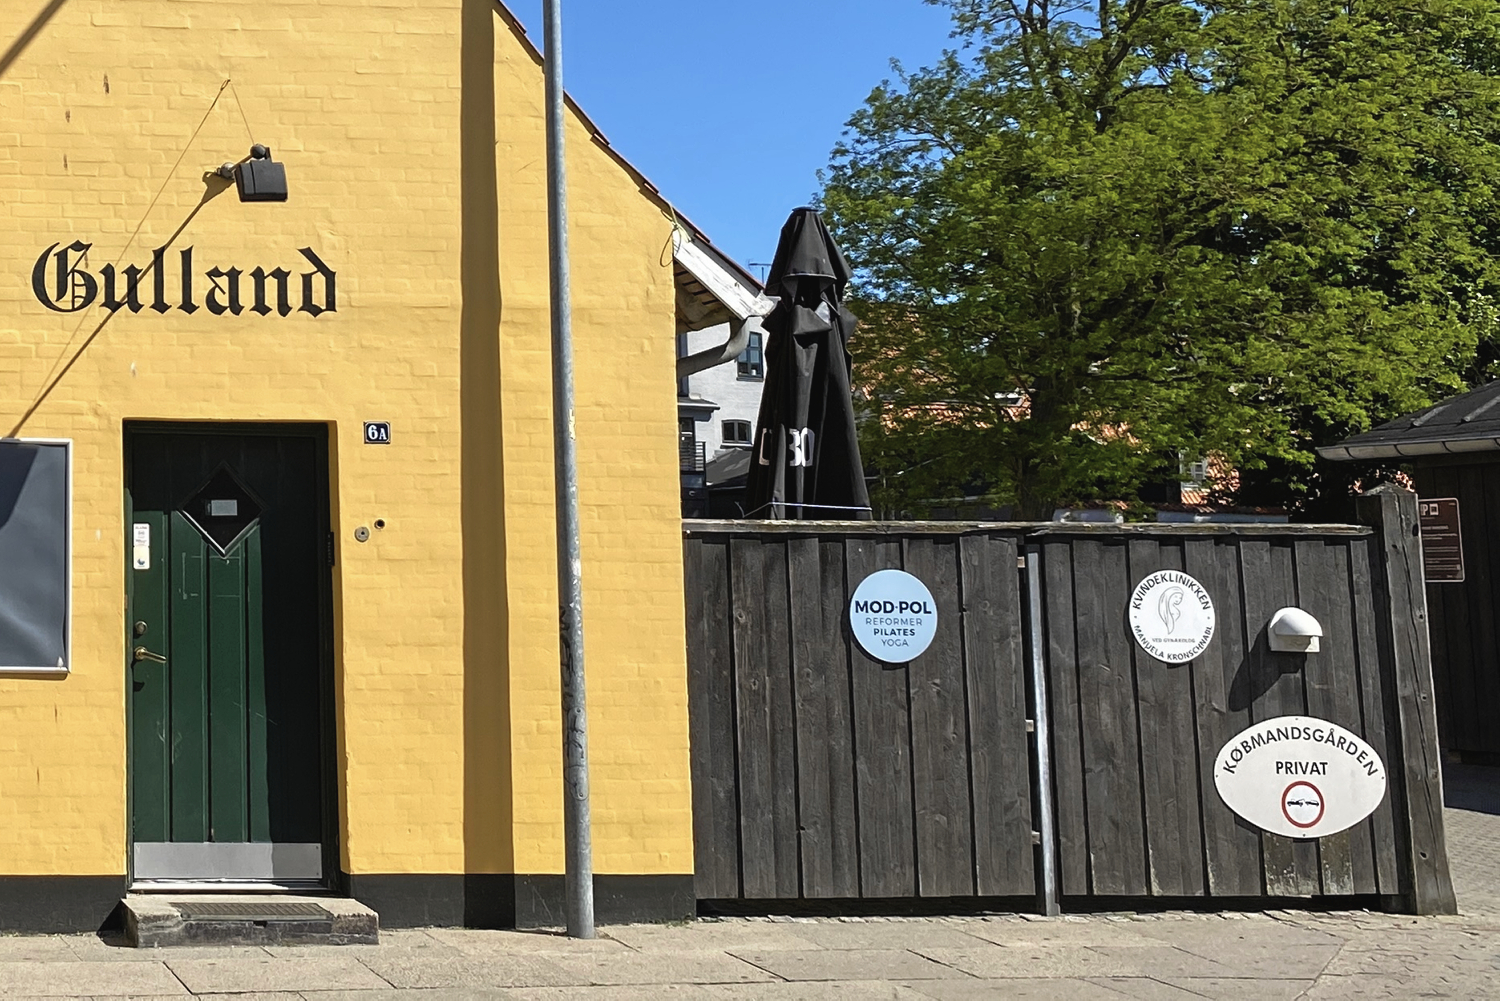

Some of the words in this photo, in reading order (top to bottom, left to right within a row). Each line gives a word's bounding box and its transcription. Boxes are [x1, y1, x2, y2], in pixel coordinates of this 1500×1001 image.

[31, 239, 337, 318] Gulland
[368, 424, 387, 440] 6A
[1132, 572, 1212, 611] KVINDEKLINIKKEN
[865, 617, 923, 626] REFORMER
[873, 628, 916, 636] PILATES
[880, 638, 910, 647] YOGA
[1134, 624, 1165, 659] MANUELA
[1222, 726, 1379, 777] KØBMANDSGÅRDEN
[1275, 761, 1329, 775] PRIVAT
